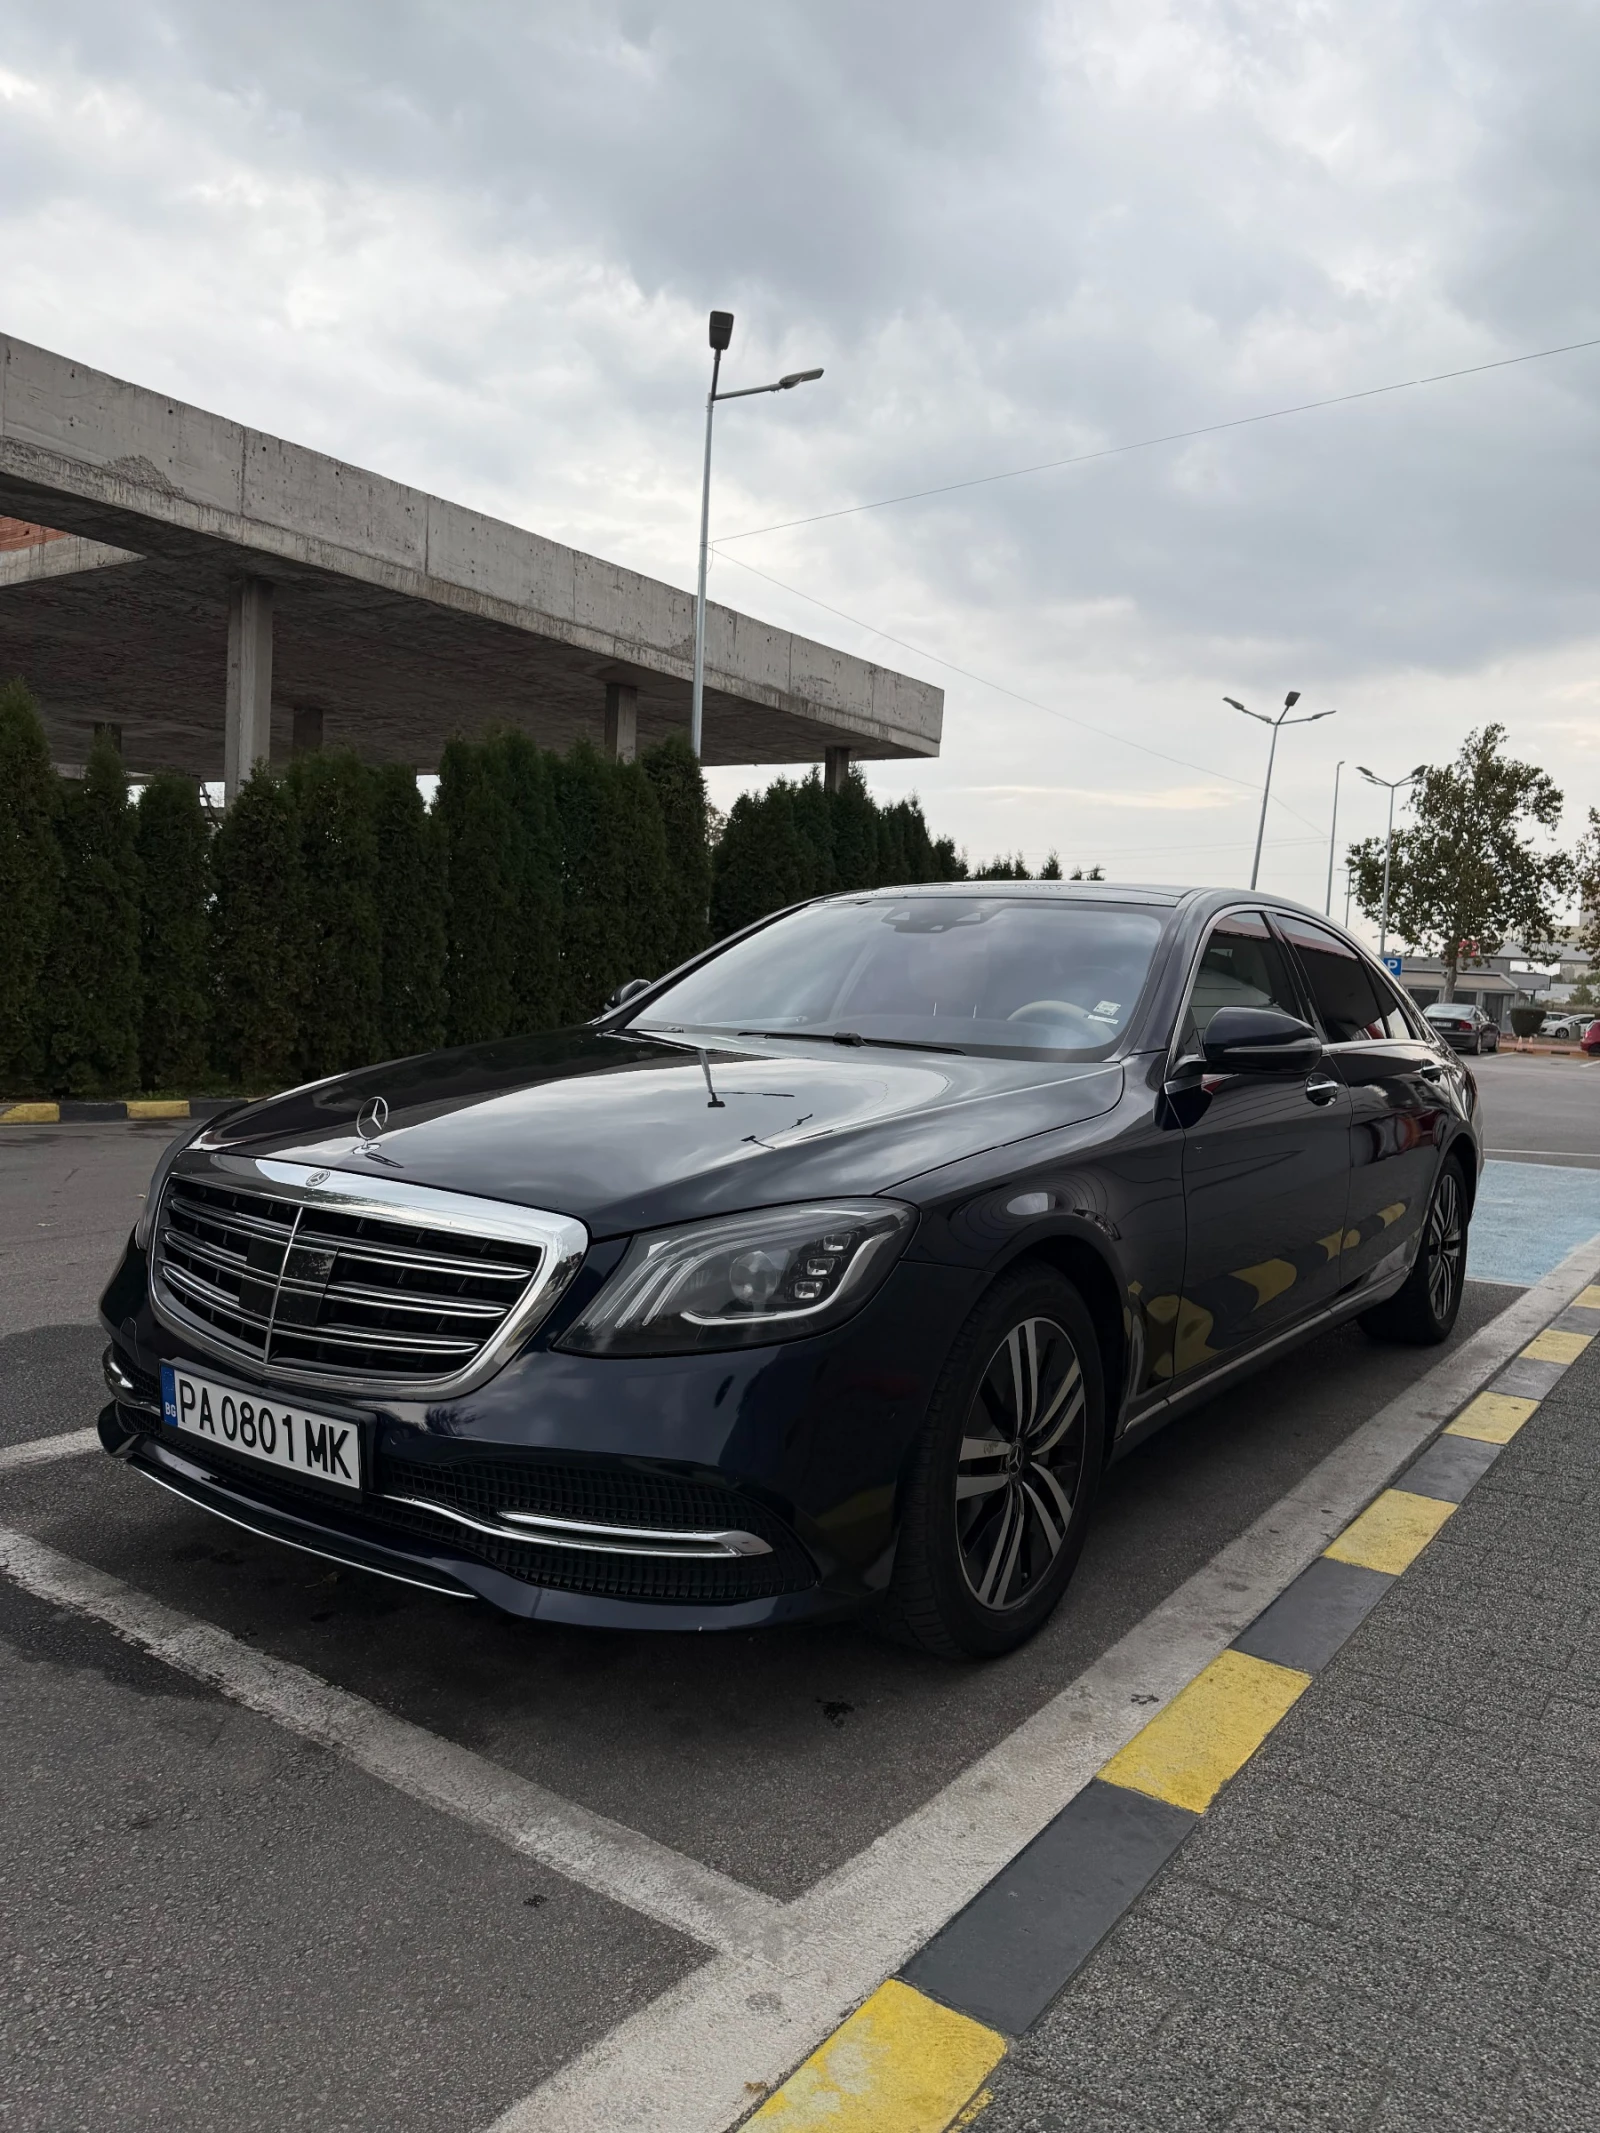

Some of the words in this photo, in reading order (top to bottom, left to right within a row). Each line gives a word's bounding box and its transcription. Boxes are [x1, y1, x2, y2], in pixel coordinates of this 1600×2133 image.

[1387, 959, 1398, 969] P
[165, 1401, 177, 1417] BG
[179, 1379, 215, 1435] PA
[221, 1395, 294, 1462] 0801
[305, 1419, 352, 1479] MK
